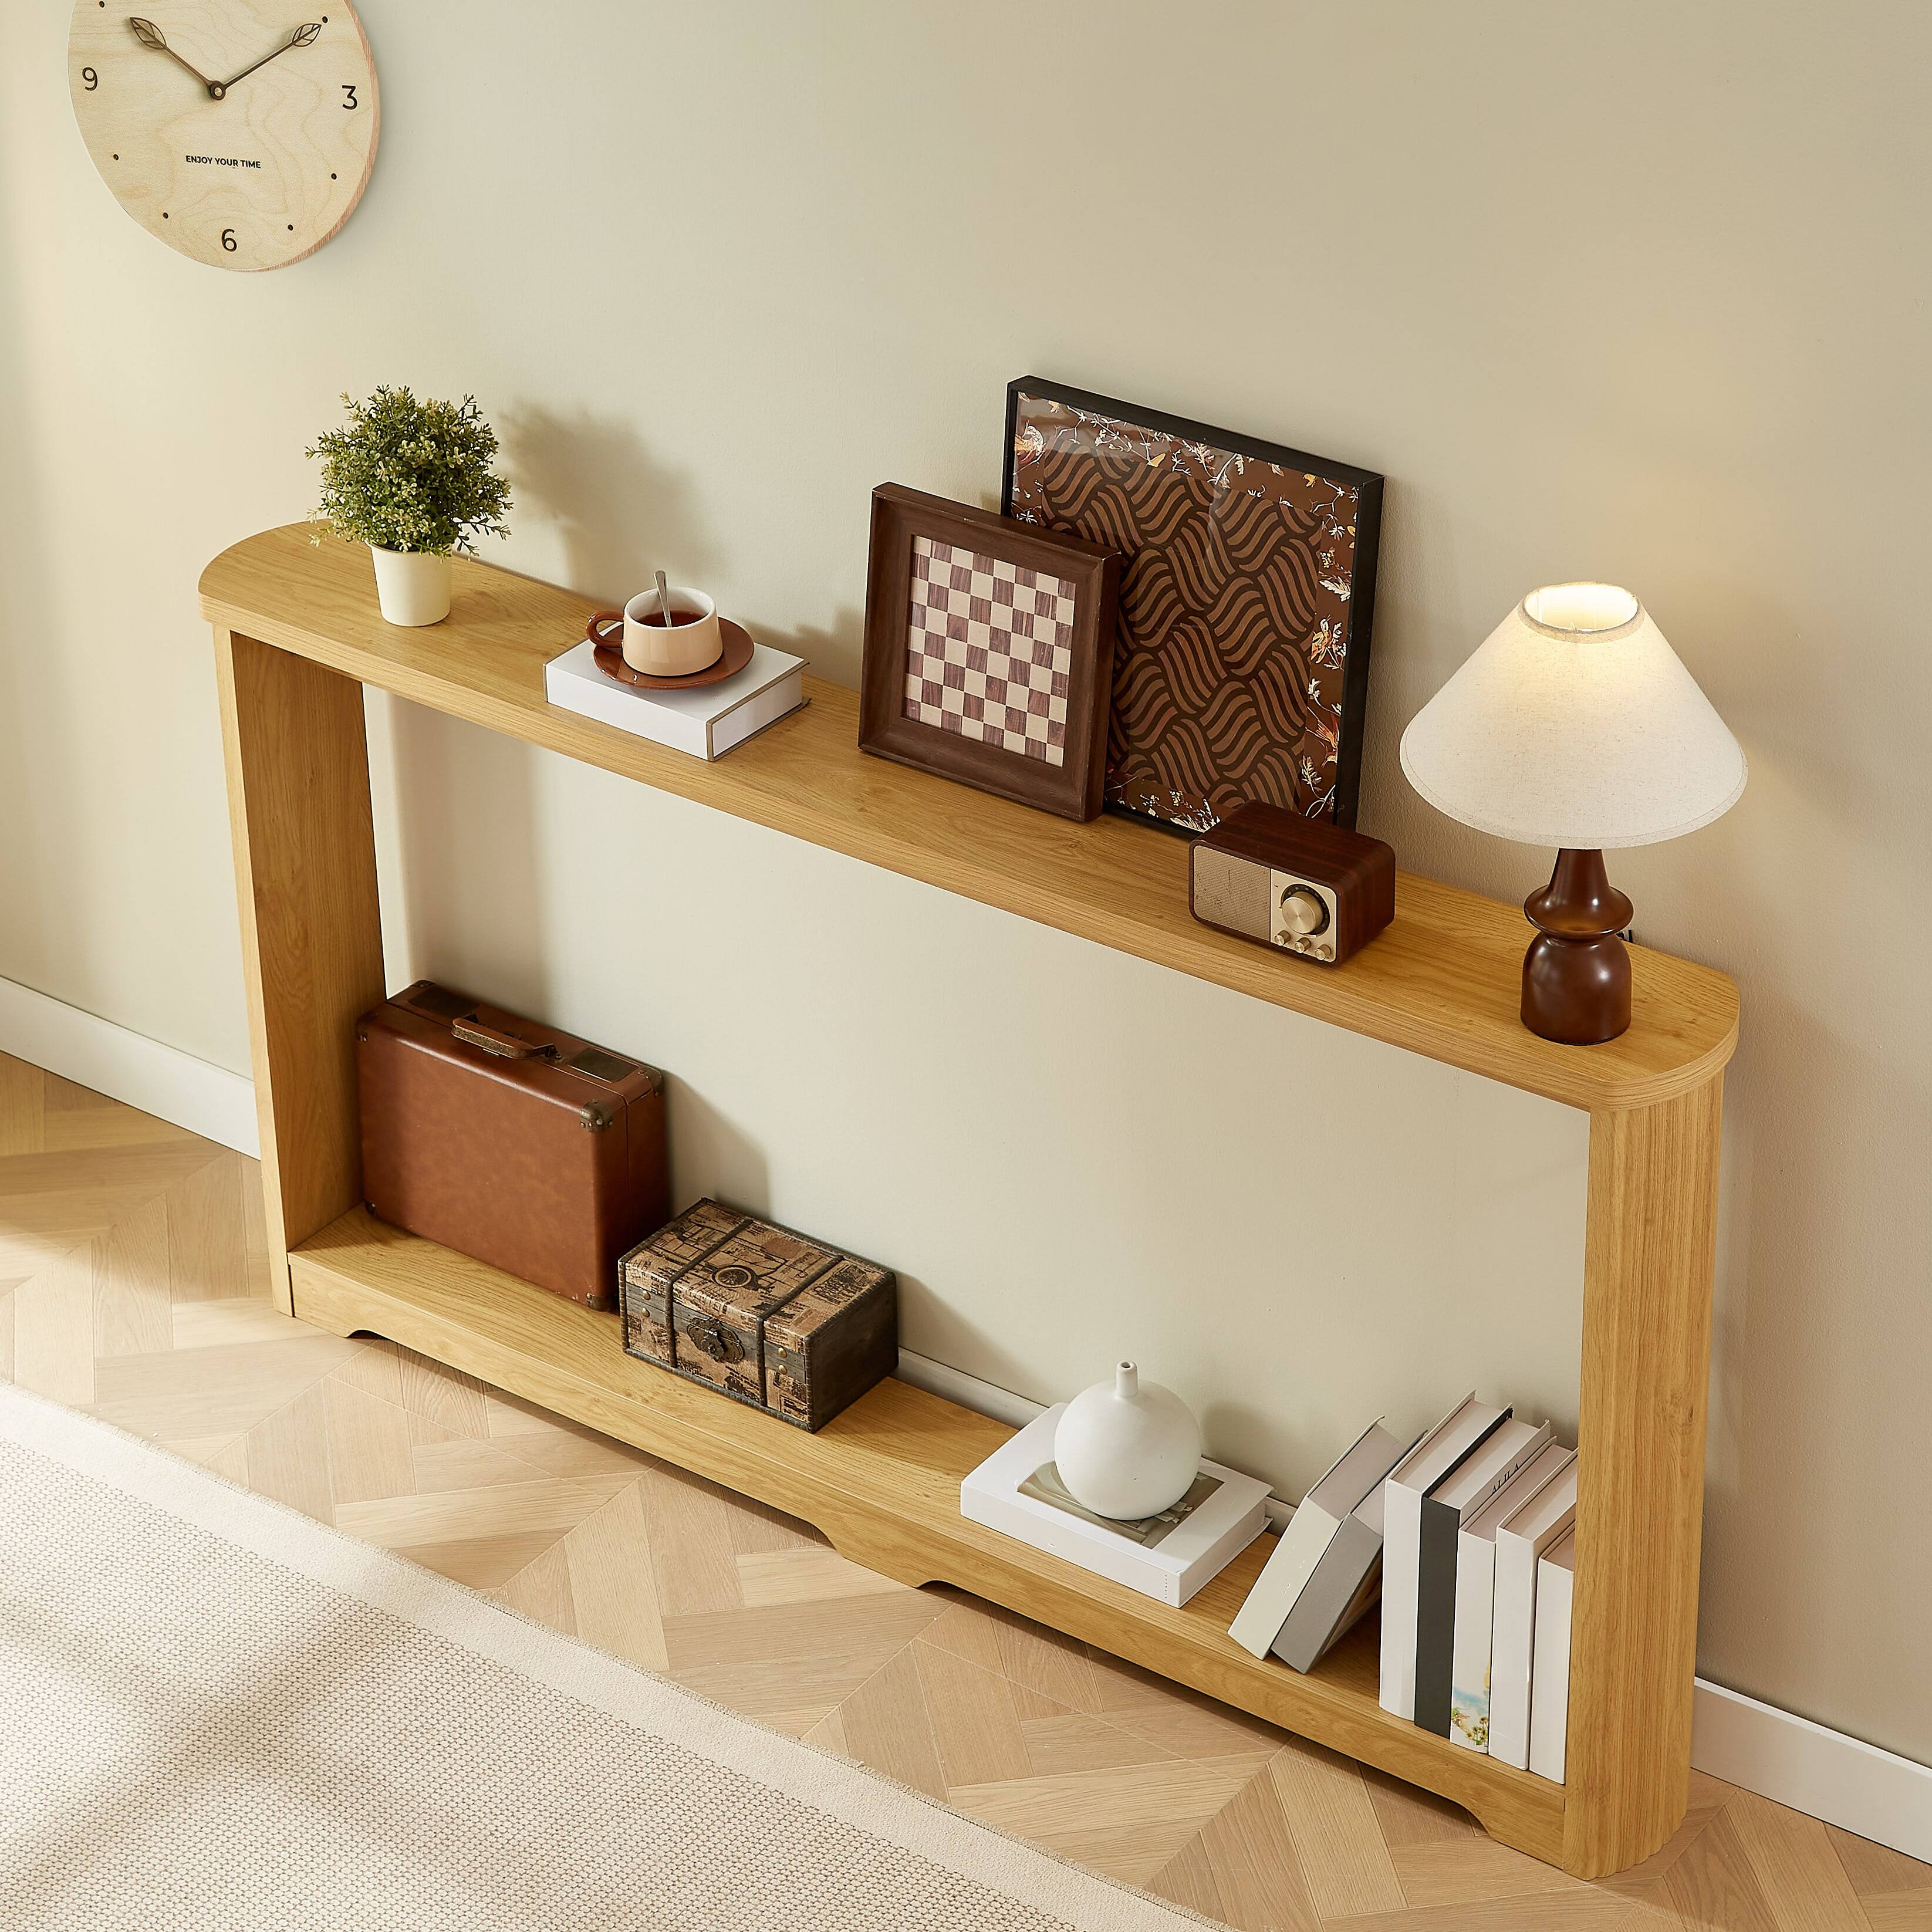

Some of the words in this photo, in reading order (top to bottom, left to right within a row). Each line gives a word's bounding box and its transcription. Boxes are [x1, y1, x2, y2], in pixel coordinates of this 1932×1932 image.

[82, 67, 98, 91] 9
[342, 85, 357, 110] 3
[185, 155, 212, 164] ENJOY
[214, 157, 238, 167] YOUR
[240, 160, 261, 169] TIME
[221, 229, 237, 252] 6
